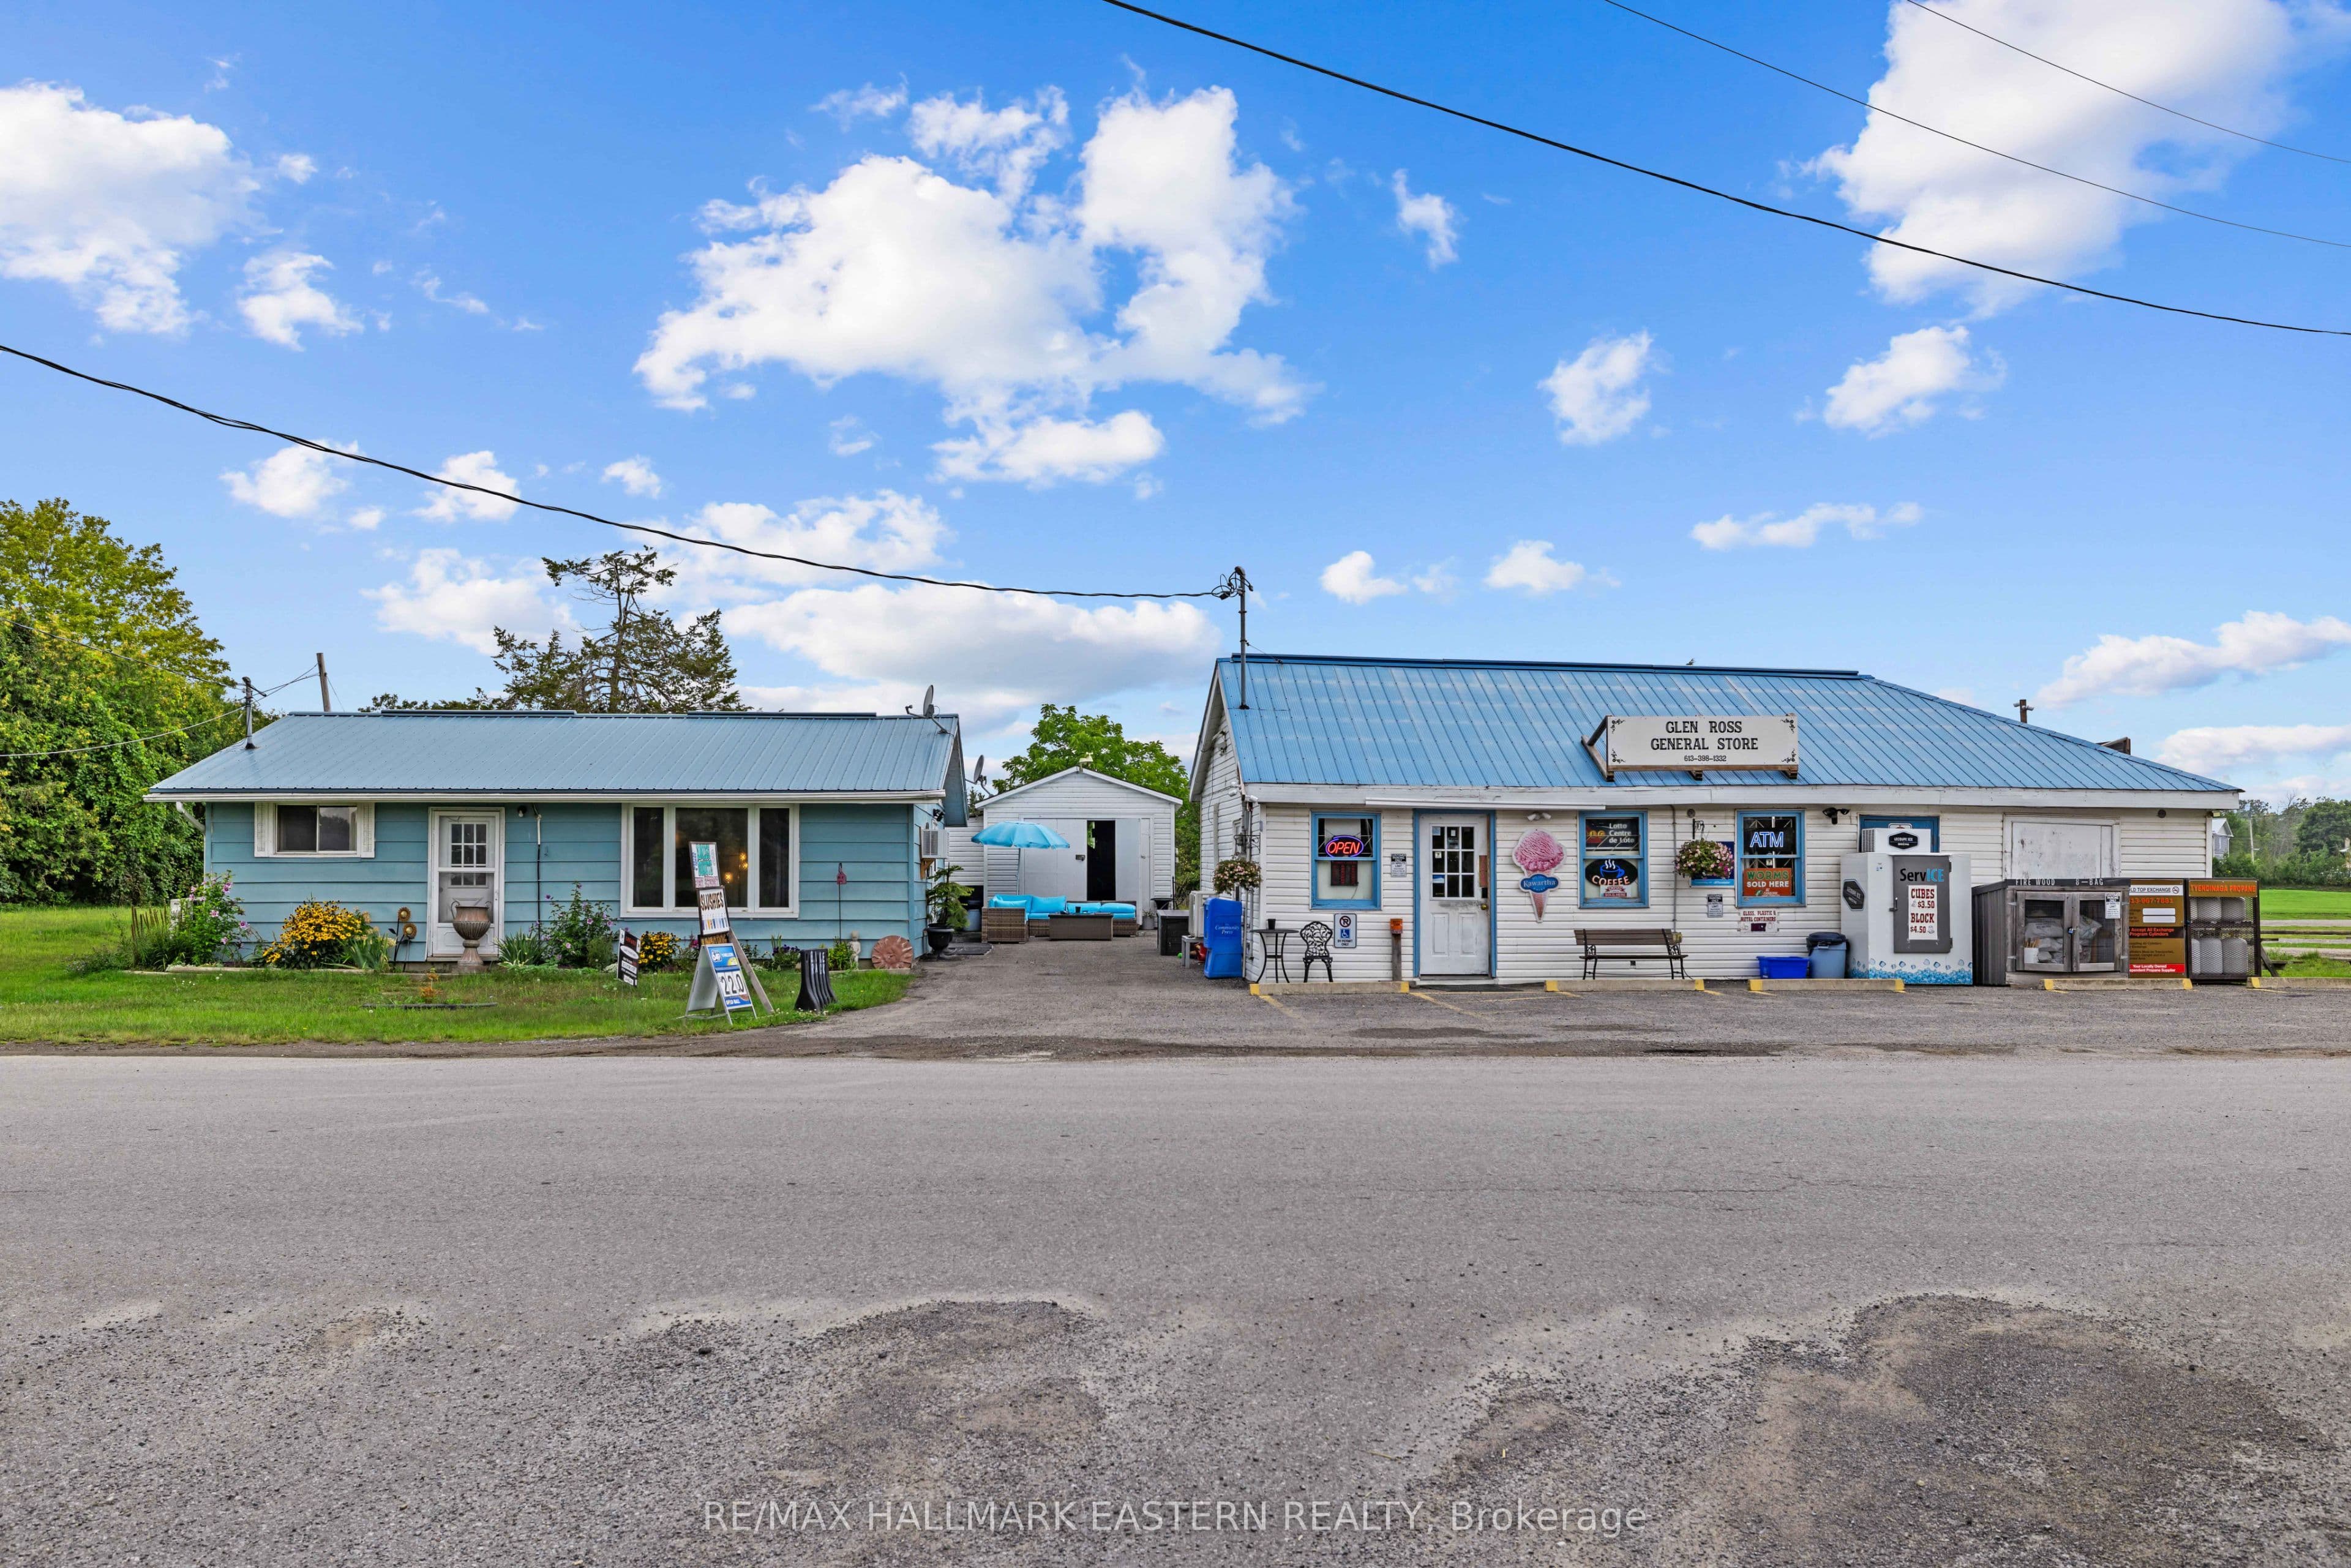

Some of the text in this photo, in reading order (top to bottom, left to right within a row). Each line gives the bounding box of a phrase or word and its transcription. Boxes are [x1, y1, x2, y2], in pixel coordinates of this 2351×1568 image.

[1665, 721, 1742, 733] GLEN ROSS
[1651, 737, 1758, 751] GENERAL STORE
[1749, 831, 1784, 848] ATM
[1327, 841, 1360, 854] OPEN
[1592, 874, 1630, 887] COFFEE
[1747, 870, 1790, 880] WORMS
[1900, 868, 1944, 882] ServICE
[1911, 888, 1935, 899] CUBES
[700, 891, 724, 912] SLUSHIES
[1918, 900, 1935, 909] $3.50
[1910, 912, 1935, 923] BLOCK
